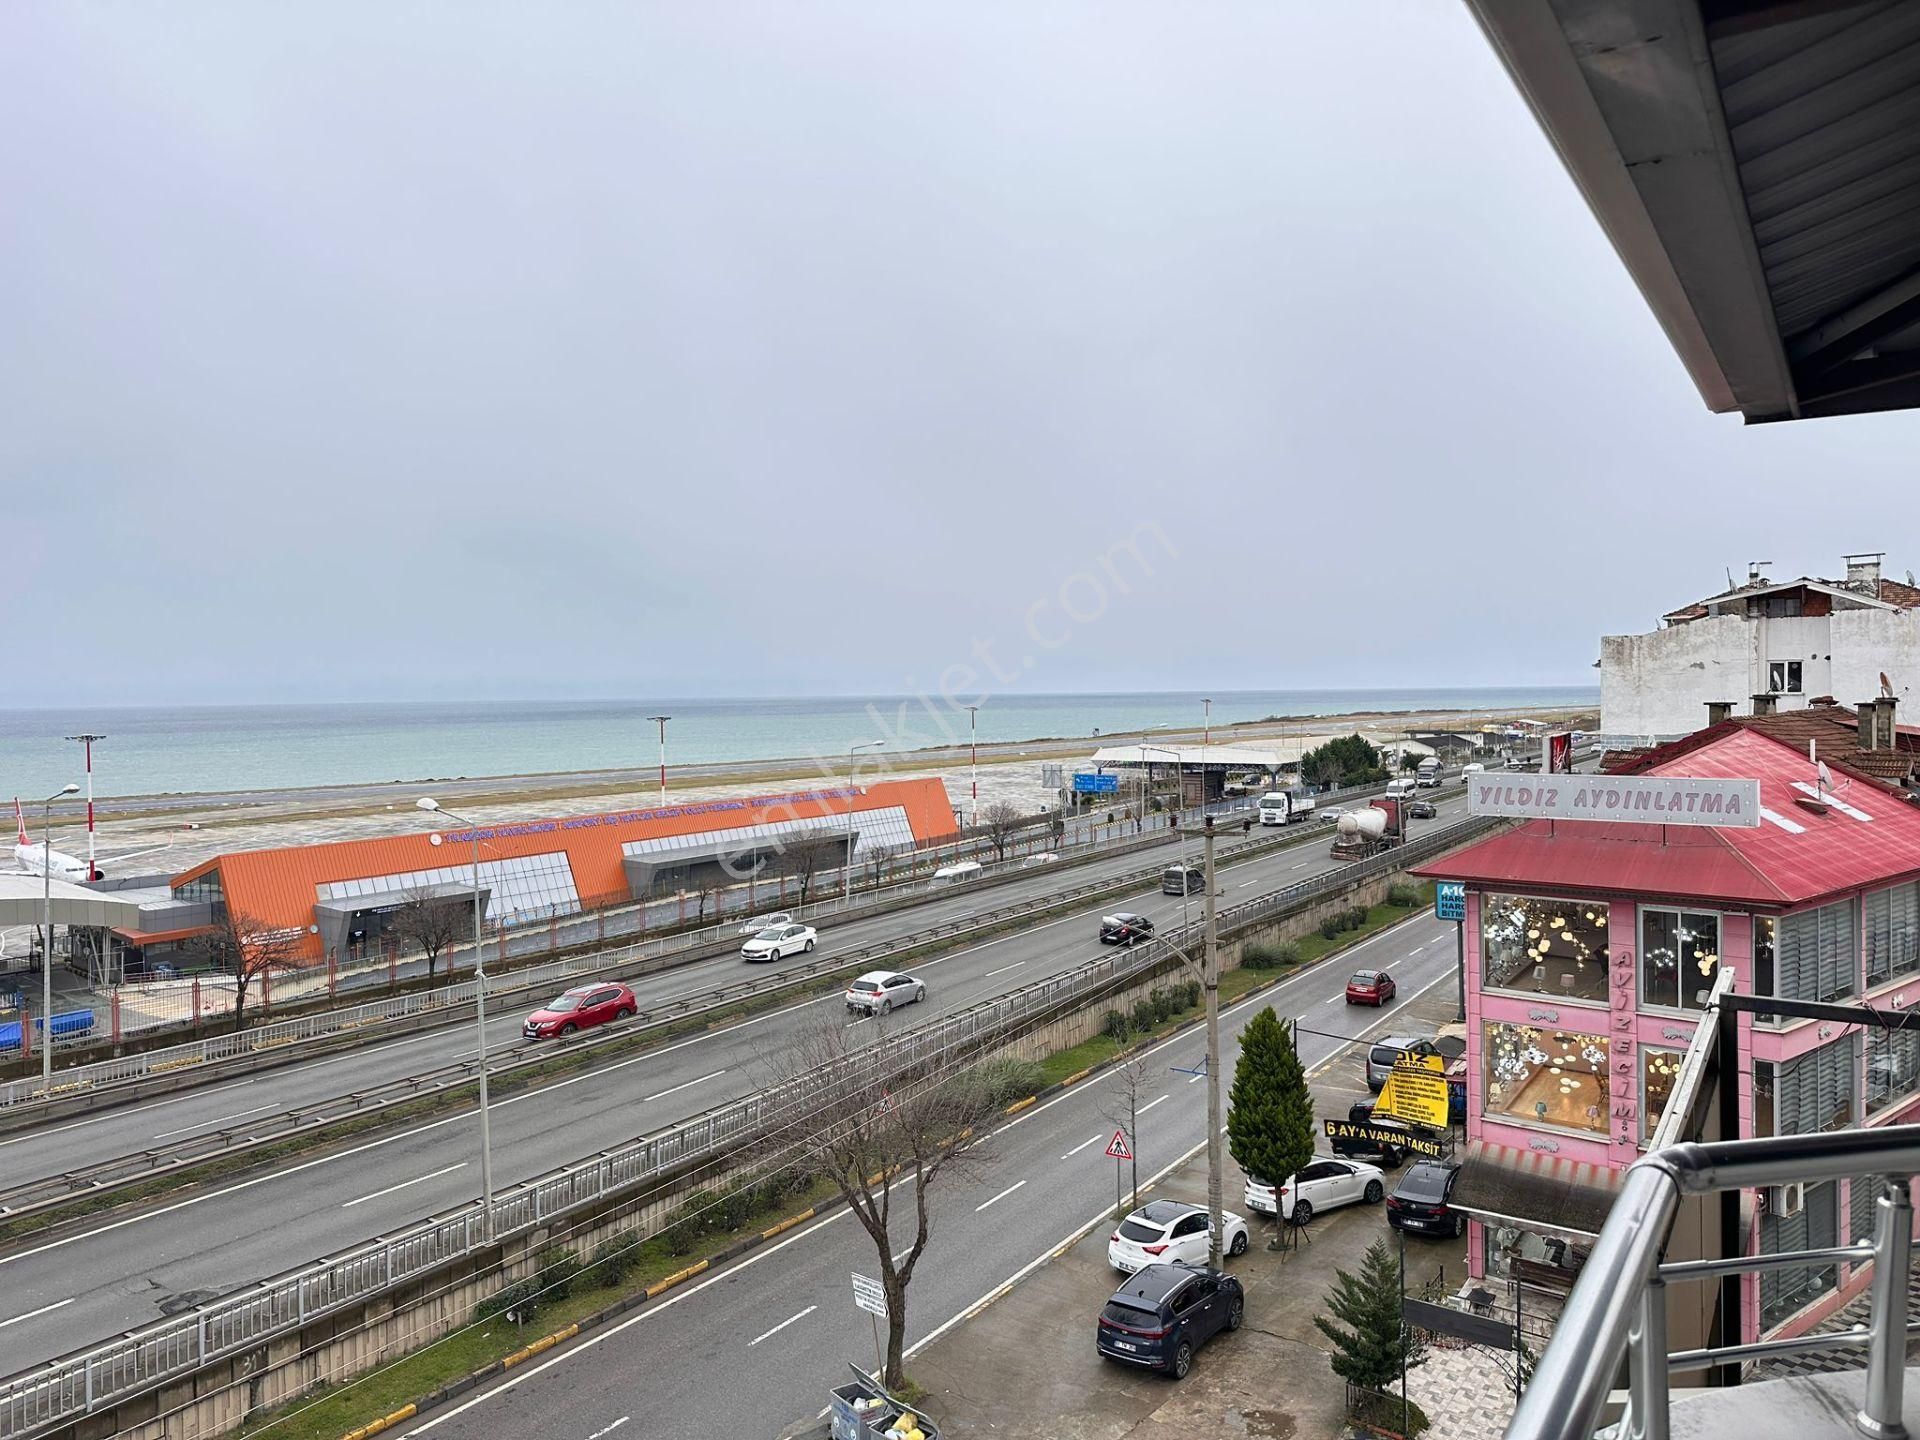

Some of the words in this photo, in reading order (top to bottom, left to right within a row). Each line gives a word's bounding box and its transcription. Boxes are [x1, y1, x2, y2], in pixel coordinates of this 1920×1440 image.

[1479, 786, 1558, 807] YILDIZ
[1573, 788, 1741, 815] AYDINLATMA
[1326, 1121, 1336, 1136] 6
[1339, 1124, 1367, 1140] AY'A
[1369, 1129, 1406, 1145] VARAN
[1406, 1136, 1440, 1157] TAKSİT
